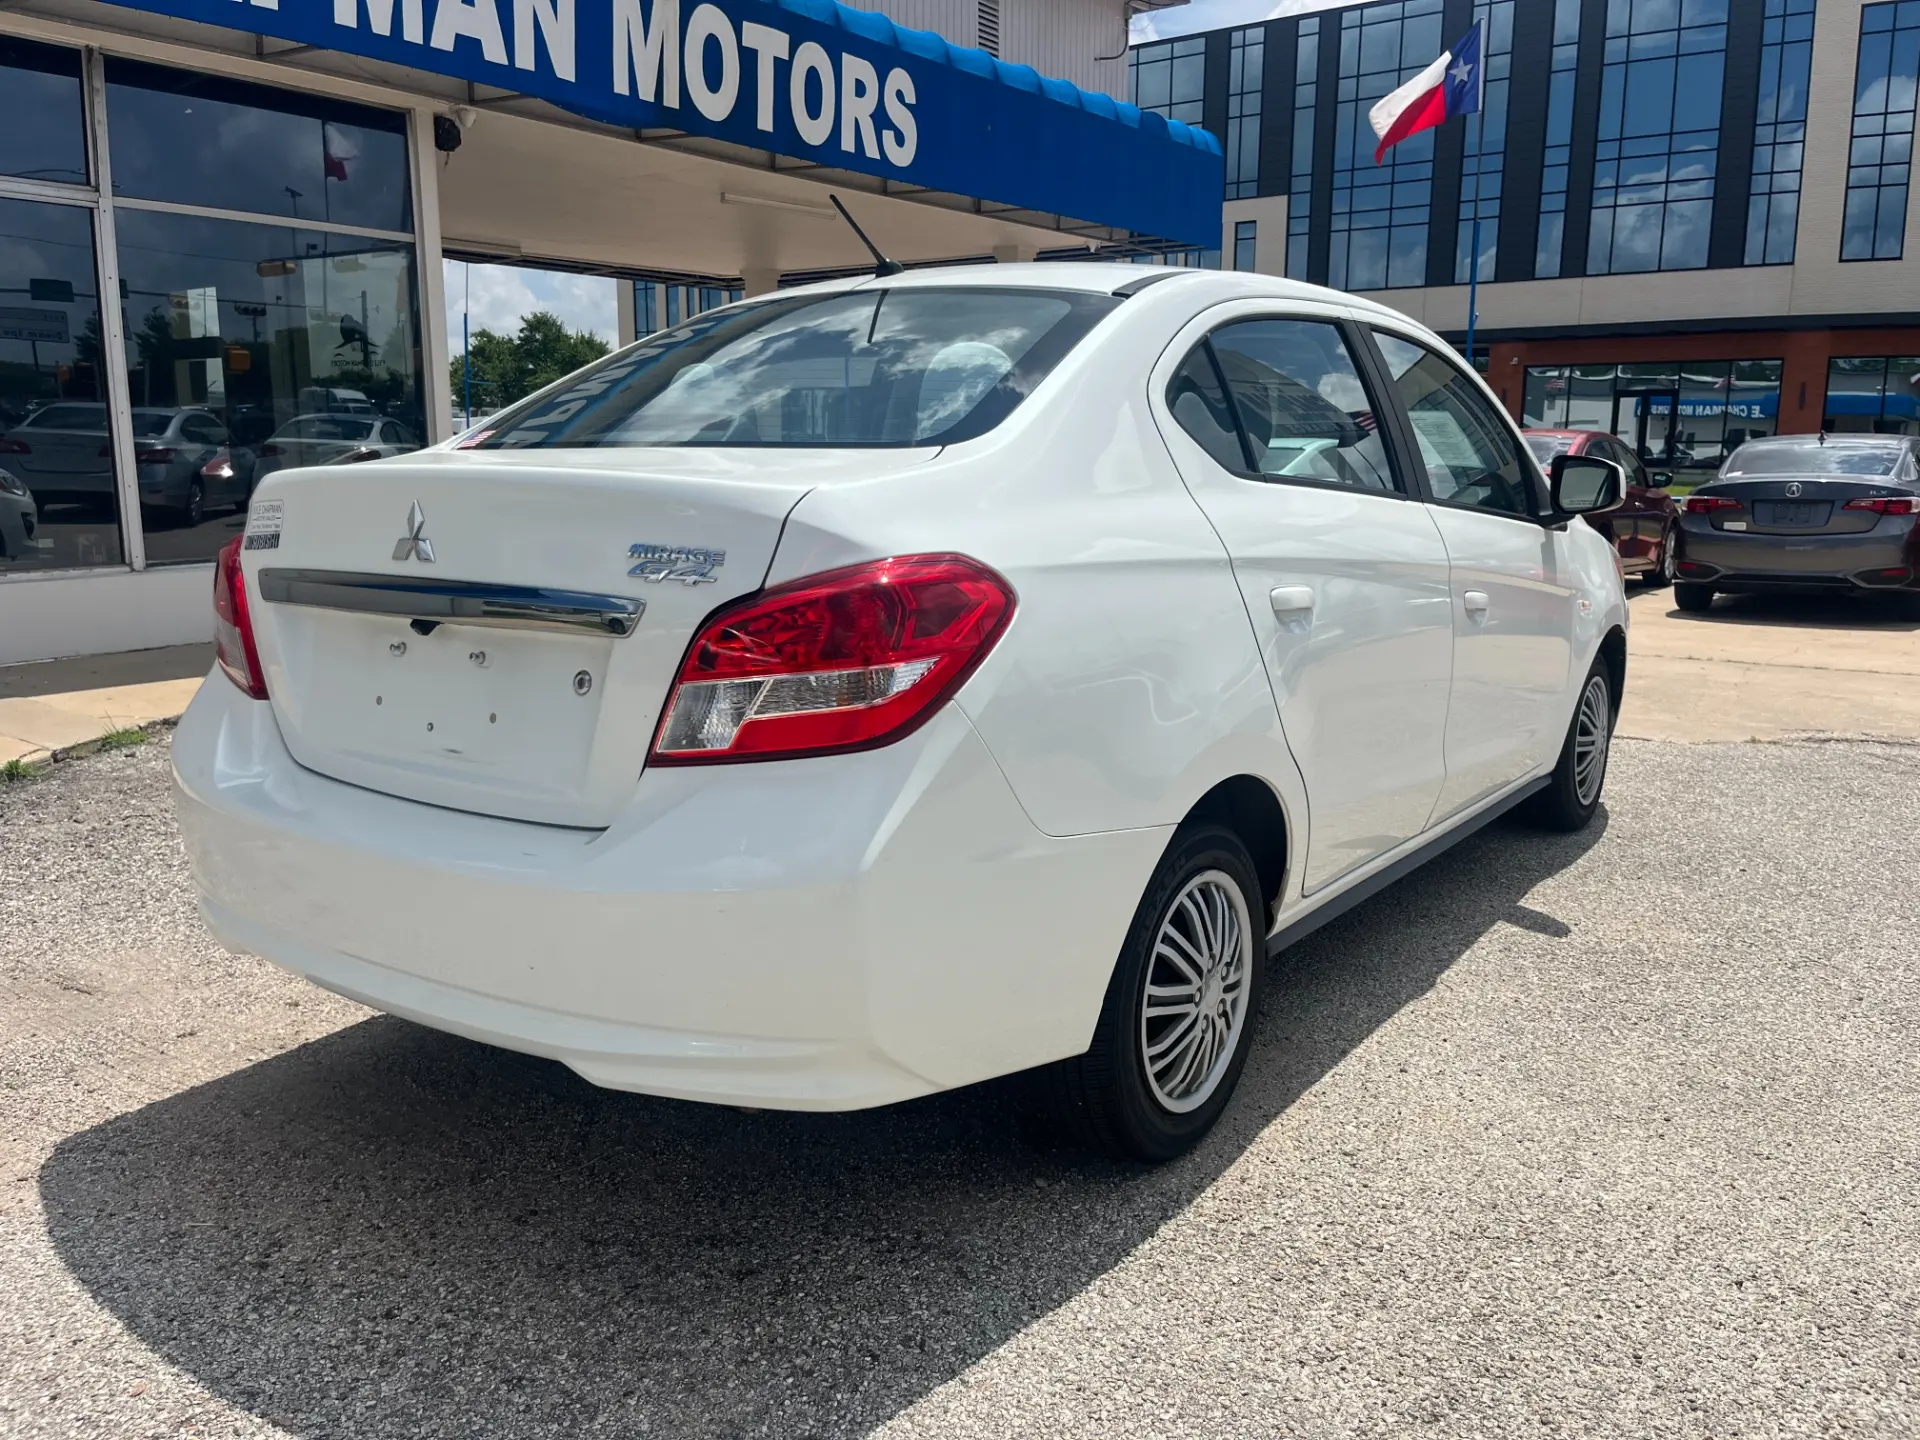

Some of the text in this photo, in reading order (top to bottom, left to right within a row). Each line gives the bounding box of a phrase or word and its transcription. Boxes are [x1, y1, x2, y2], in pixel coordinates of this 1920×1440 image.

[612, 0, 918, 168] MOTORS
[627, 544, 726, 567] MIRAGE
[627, 561, 718, 587] G4
